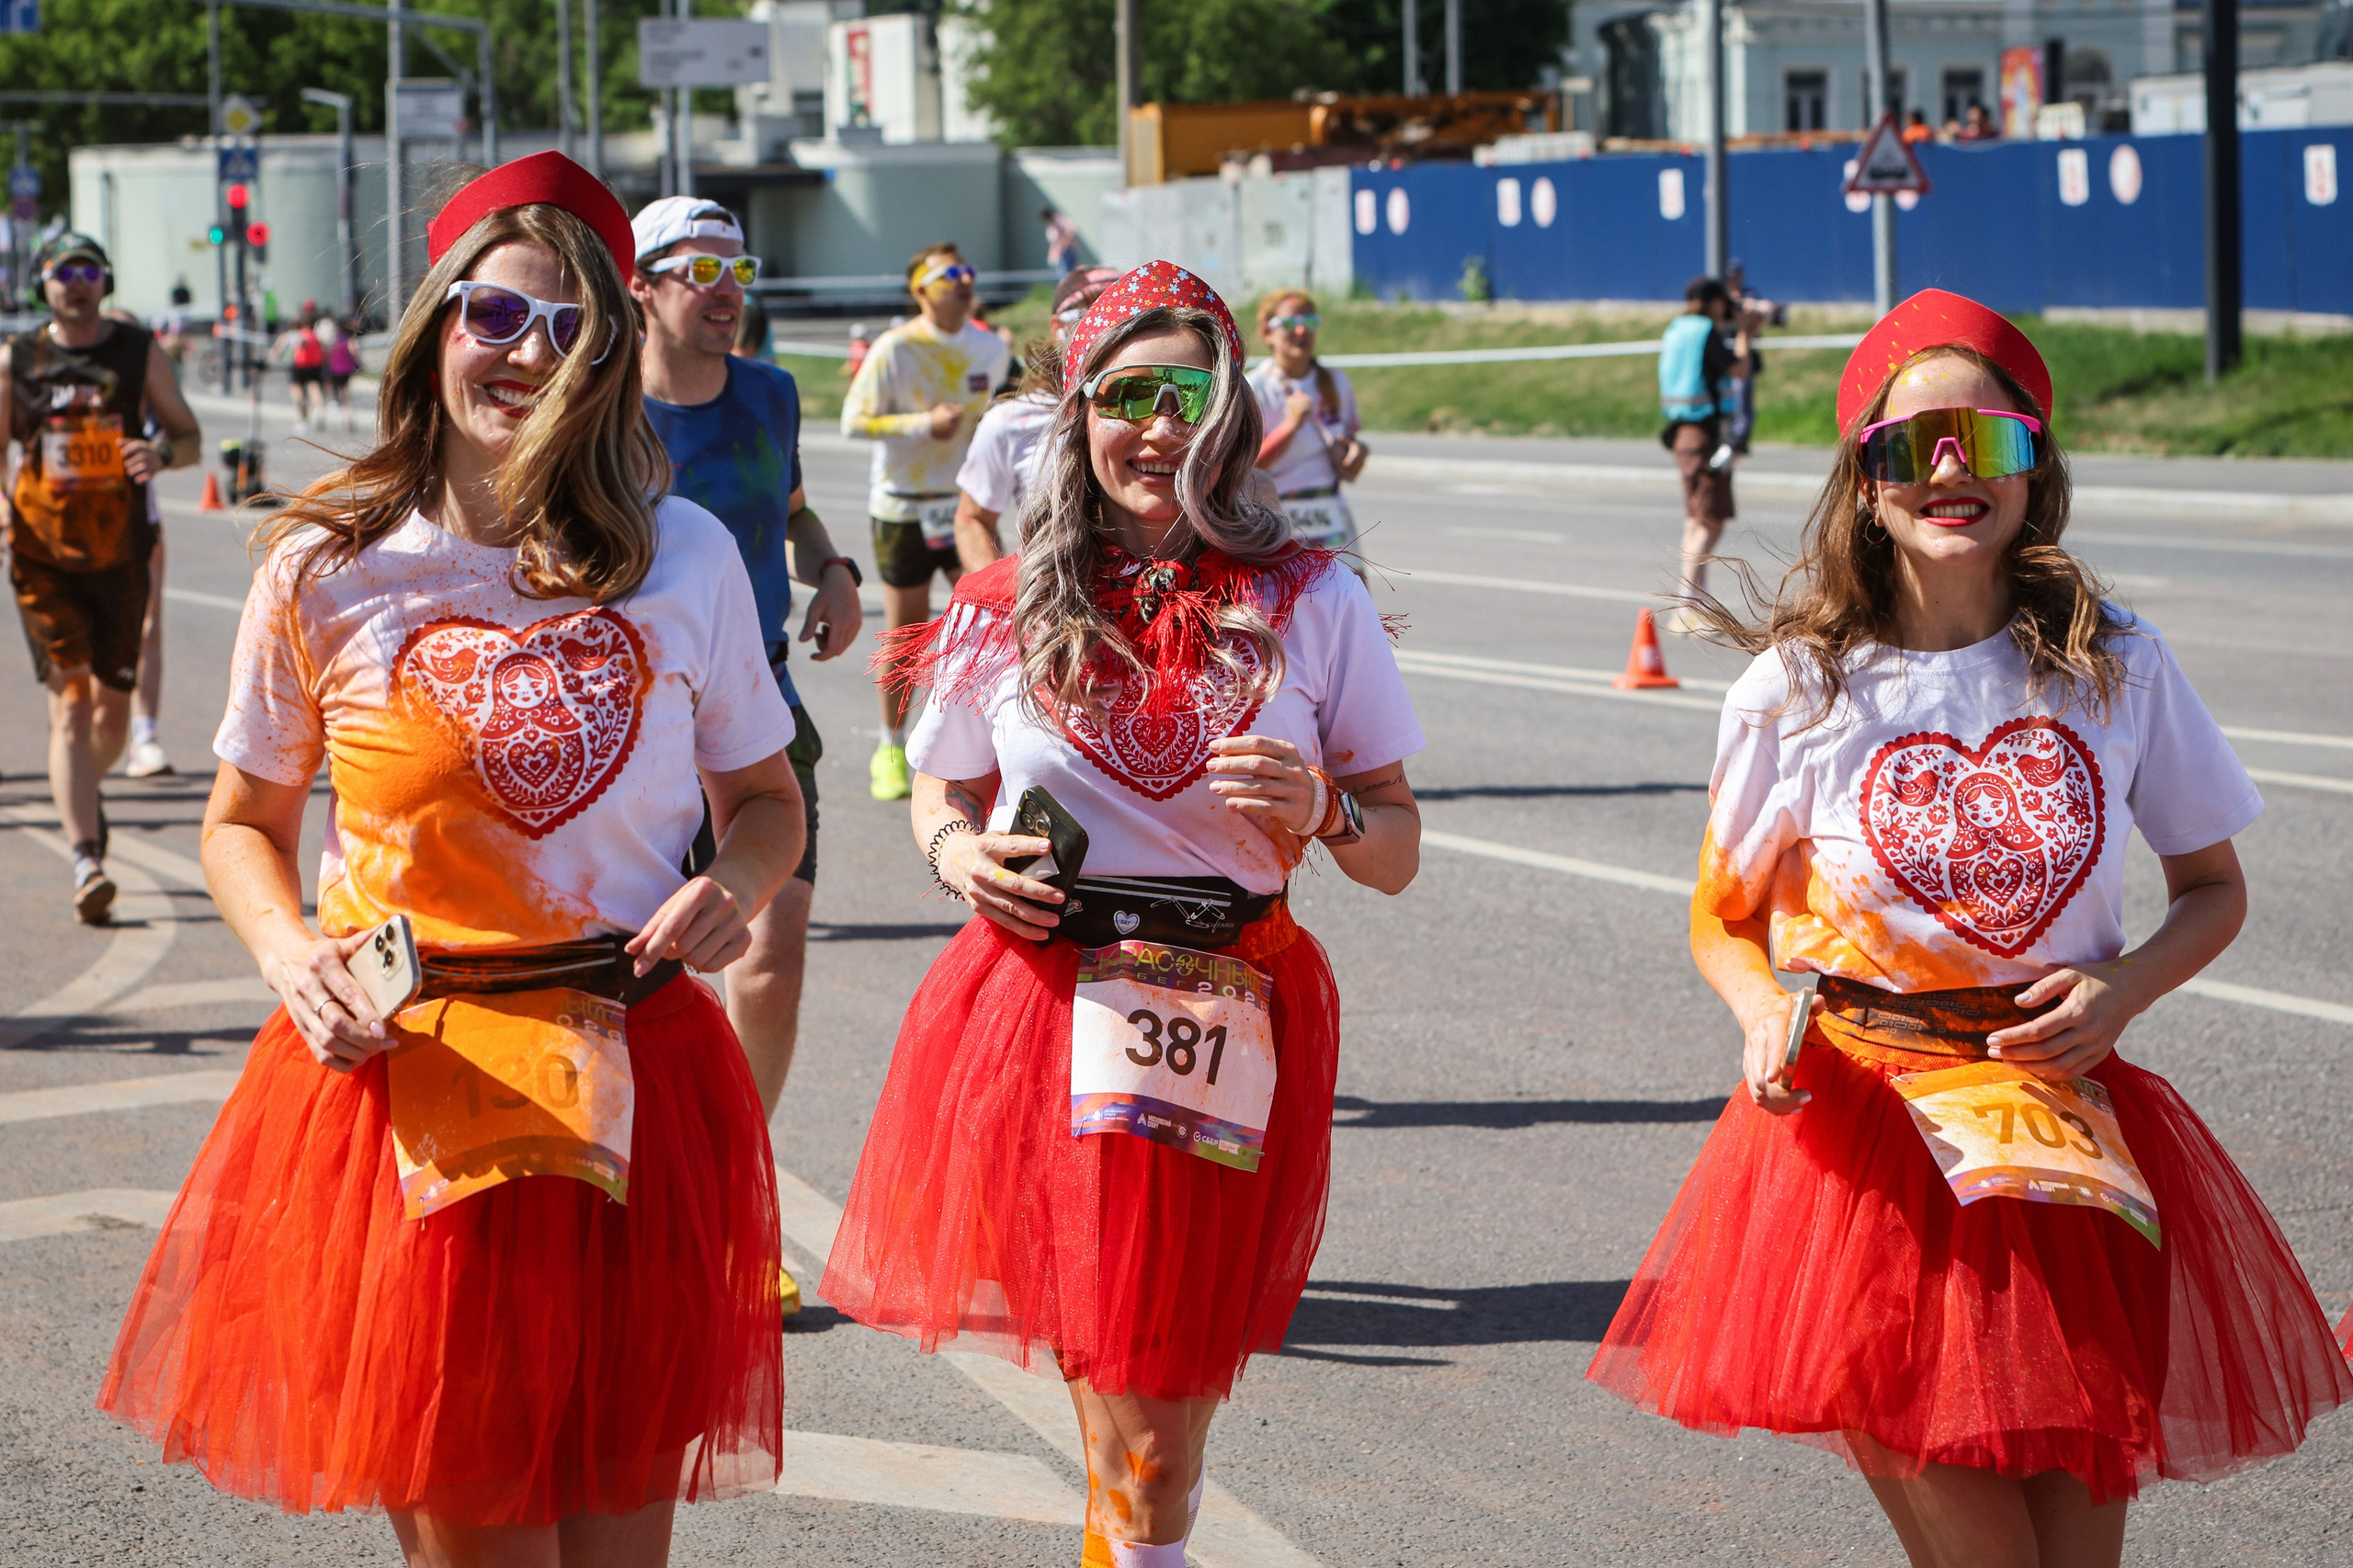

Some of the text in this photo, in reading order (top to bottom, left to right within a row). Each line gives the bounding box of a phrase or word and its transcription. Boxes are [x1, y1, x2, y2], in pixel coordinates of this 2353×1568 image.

[56, 442, 112, 468] 3310
[1125, 1009, 1228, 1086] 381
[451, 1053, 580, 1119] 130
[1201, 1135, 1219, 1146] СБЕР
[1972, 1102, 2104, 1160] 703
